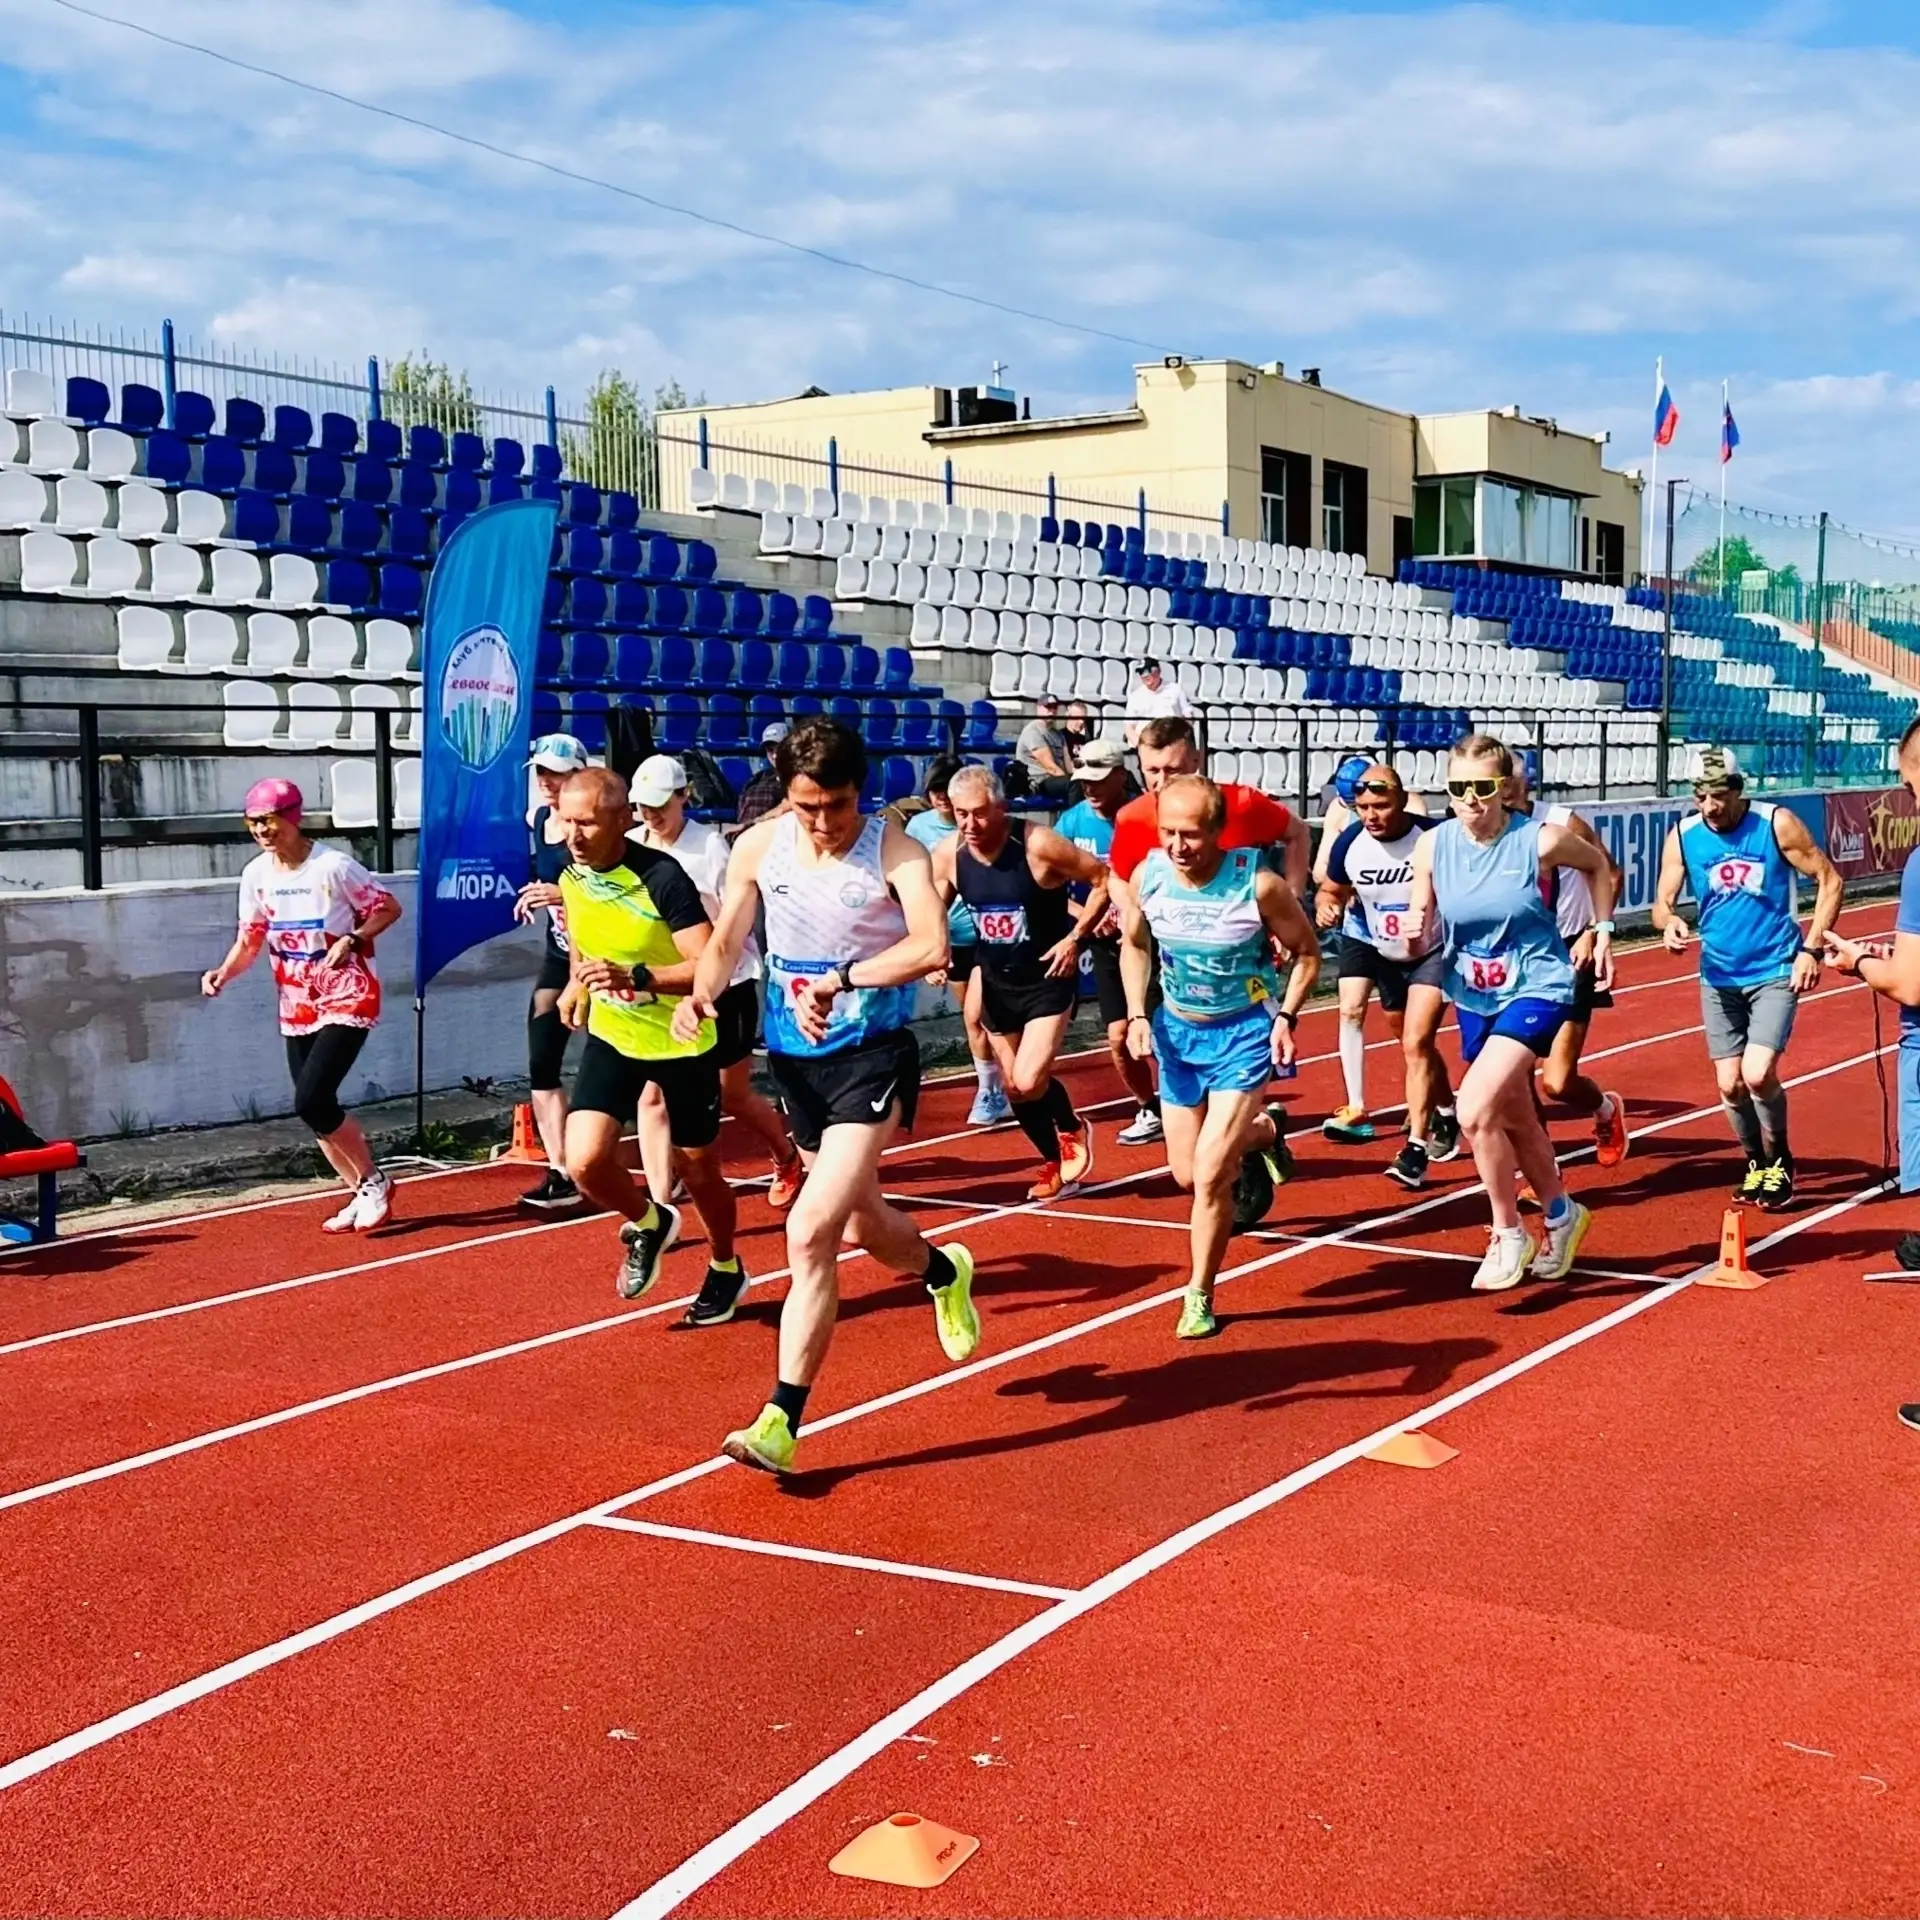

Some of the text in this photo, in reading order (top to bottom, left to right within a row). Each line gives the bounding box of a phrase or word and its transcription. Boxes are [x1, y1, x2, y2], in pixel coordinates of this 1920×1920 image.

[1594, 809, 1699, 908] ГАЗП
[1720, 863, 1752, 887] 97
[1385, 914, 1399, 936] 8
[280, 931, 308, 950] 61
